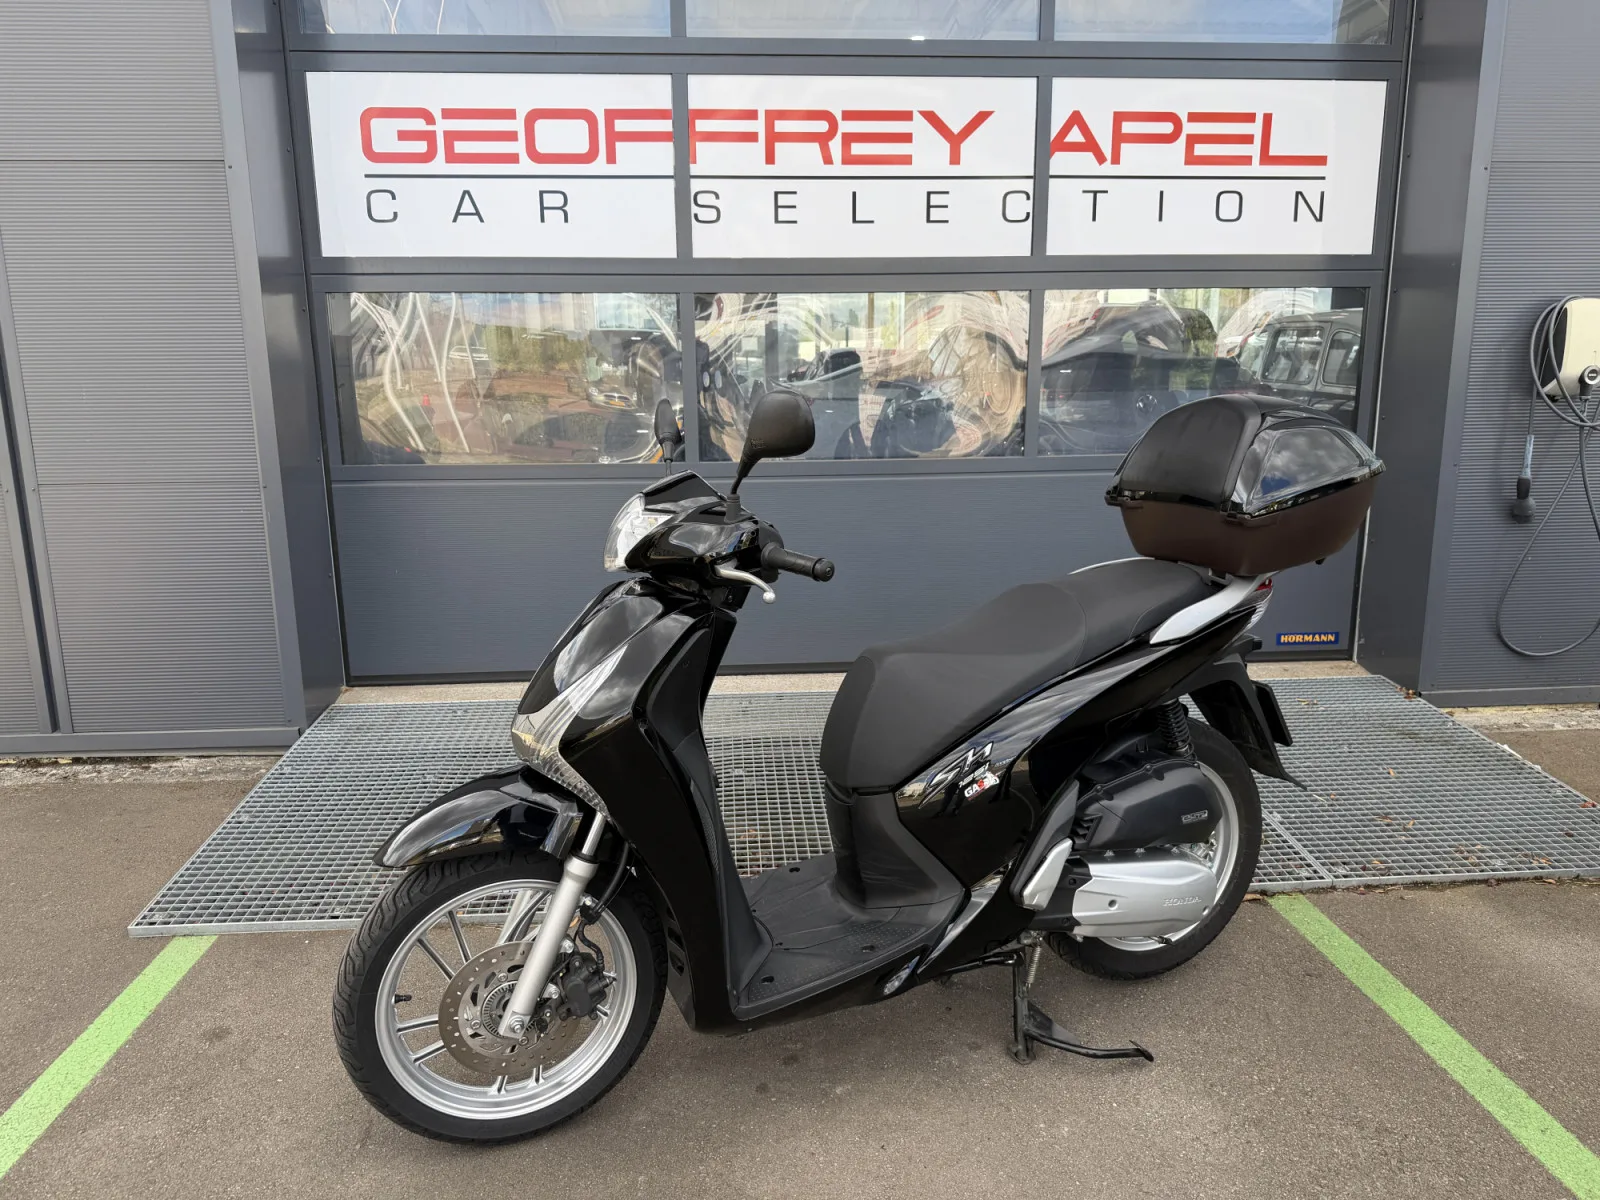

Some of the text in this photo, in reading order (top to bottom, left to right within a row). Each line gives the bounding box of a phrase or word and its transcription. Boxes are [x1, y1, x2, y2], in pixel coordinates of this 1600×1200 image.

[359, 106, 1329, 167] GEOFFREY APEL
[365, 189, 1326, 225] CAR SELECTION
